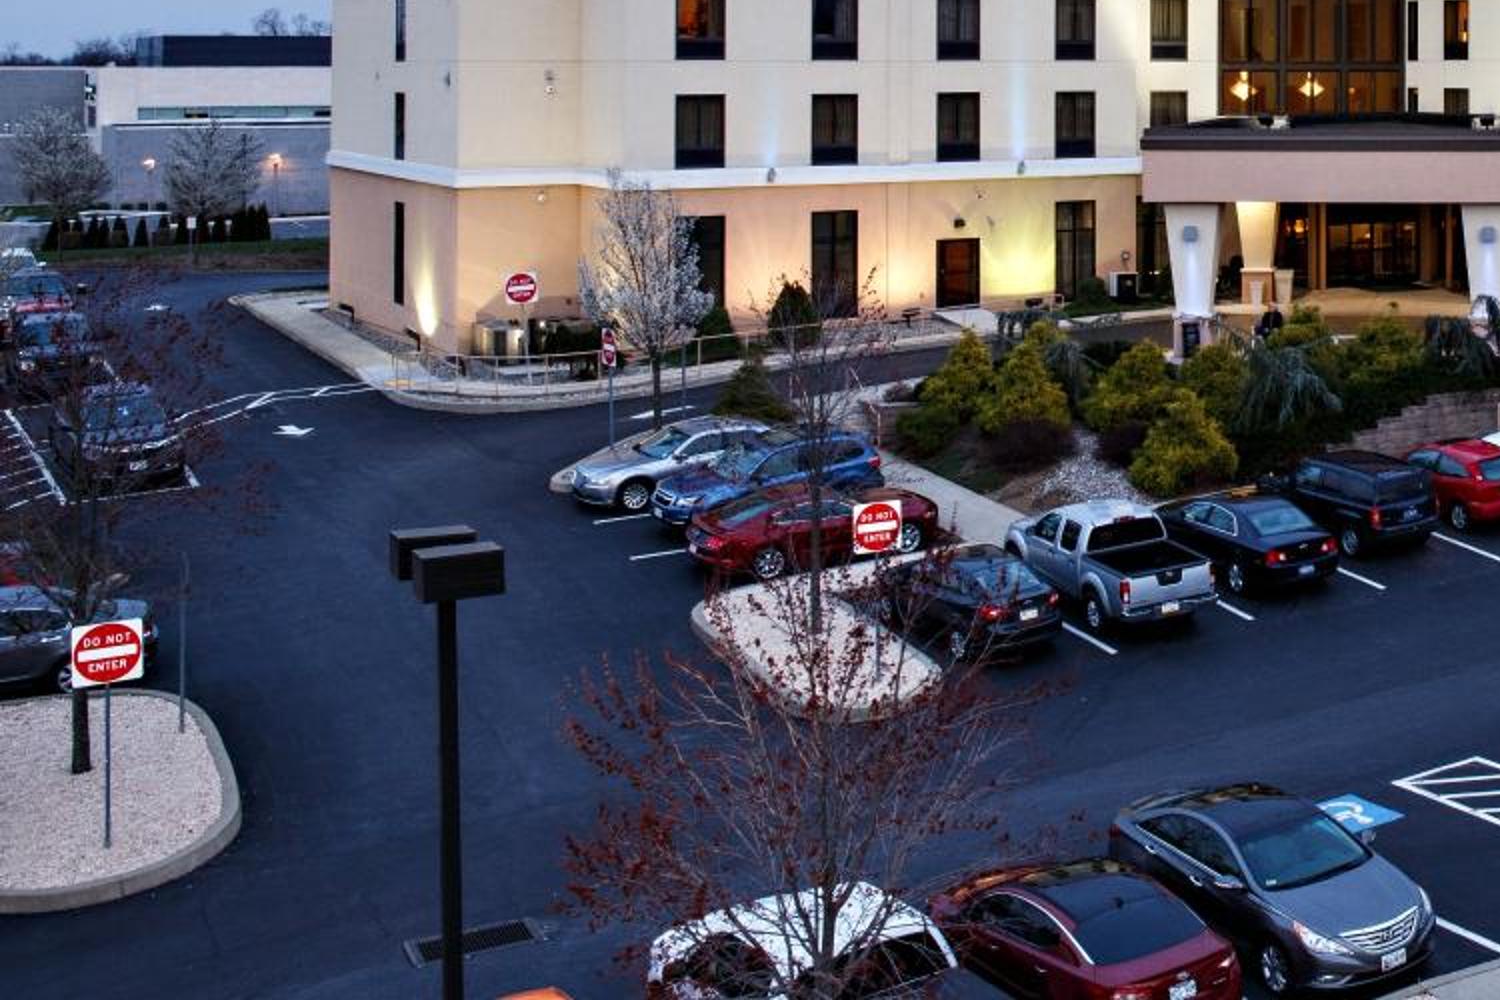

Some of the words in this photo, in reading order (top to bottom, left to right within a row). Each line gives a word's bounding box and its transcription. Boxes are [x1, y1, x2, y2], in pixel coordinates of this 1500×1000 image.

[83, 637, 101, 648] DO
[105, 631, 132, 645] NOT
[87, 658, 127, 673] ENTER
